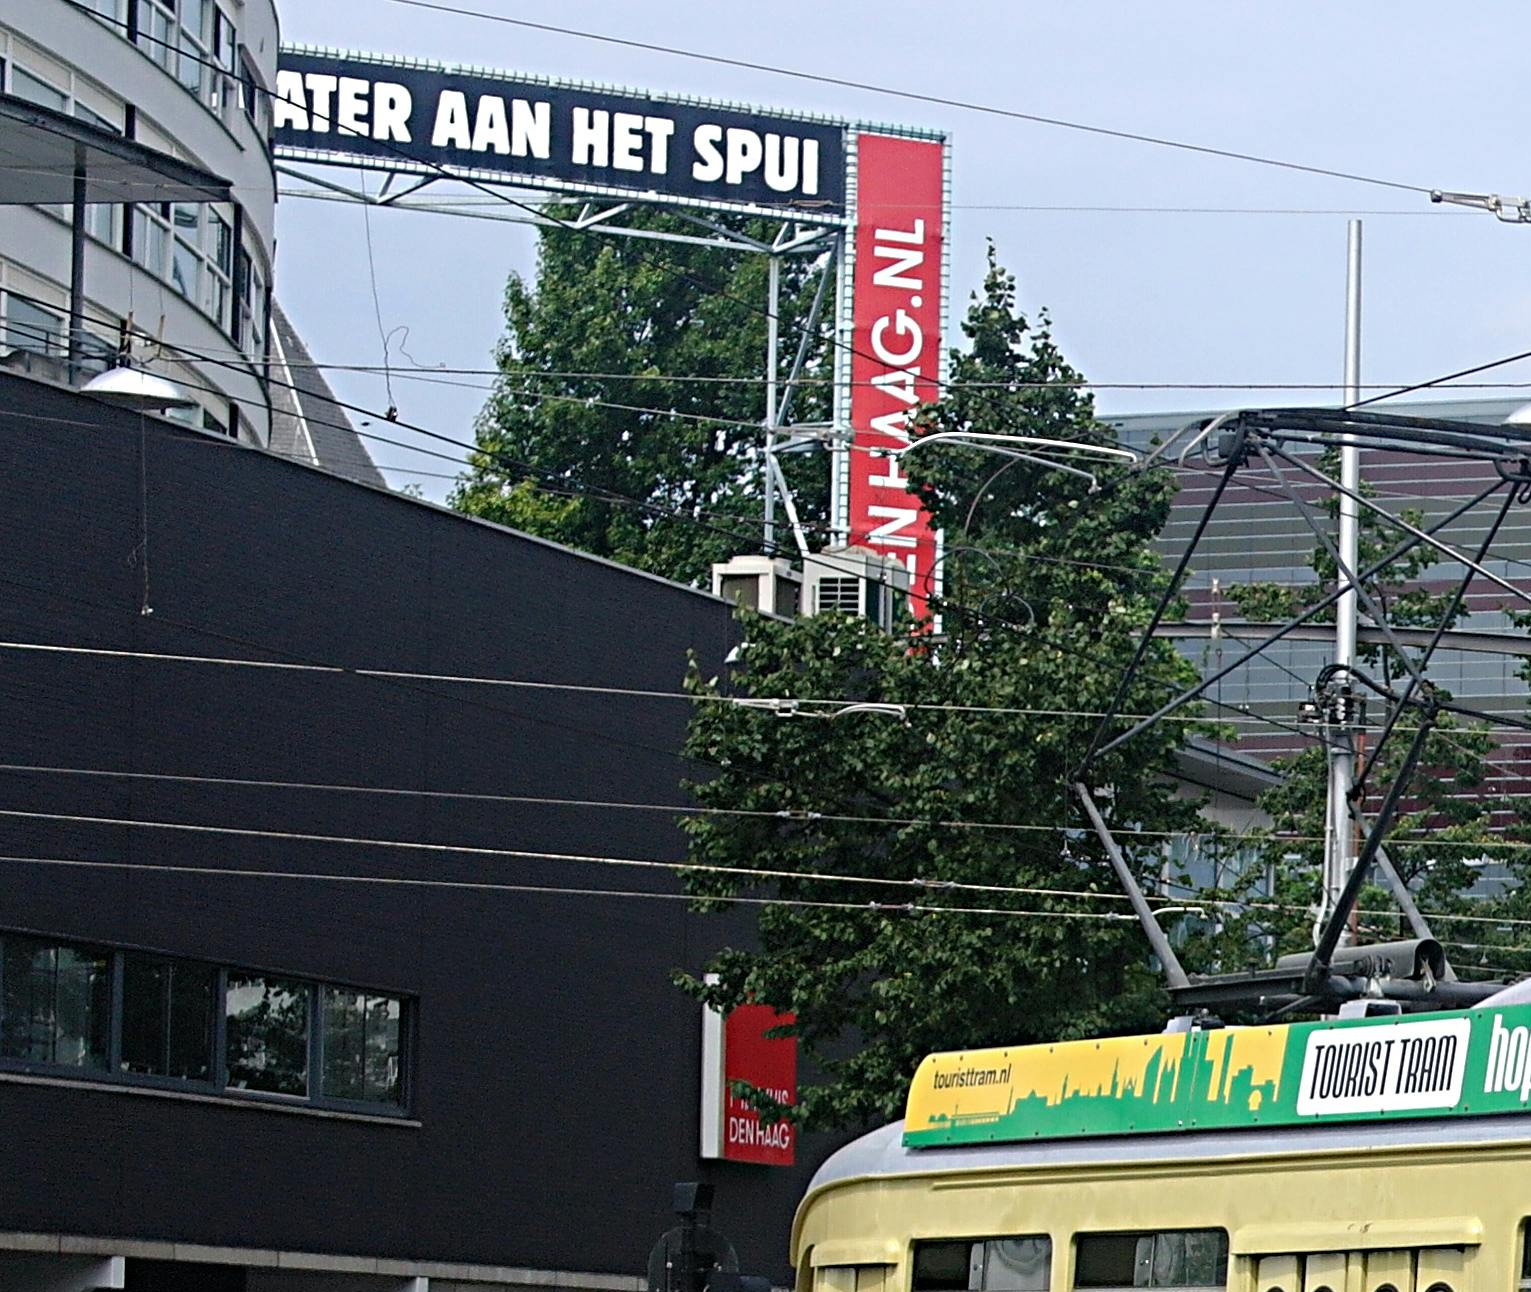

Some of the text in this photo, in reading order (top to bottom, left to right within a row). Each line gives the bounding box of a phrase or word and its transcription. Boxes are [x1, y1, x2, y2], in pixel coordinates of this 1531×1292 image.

[431, 89, 551, 159] AAN
[572, 106, 675, 175] HET
[692, 123, 819, 195] SPUI
[933, 1063, 1012, 1089] touristtram.nl
[1309, 1034, 1458, 1100] TOURIST TRAM
[729, 1117, 790, 1149] DEN HAAG
